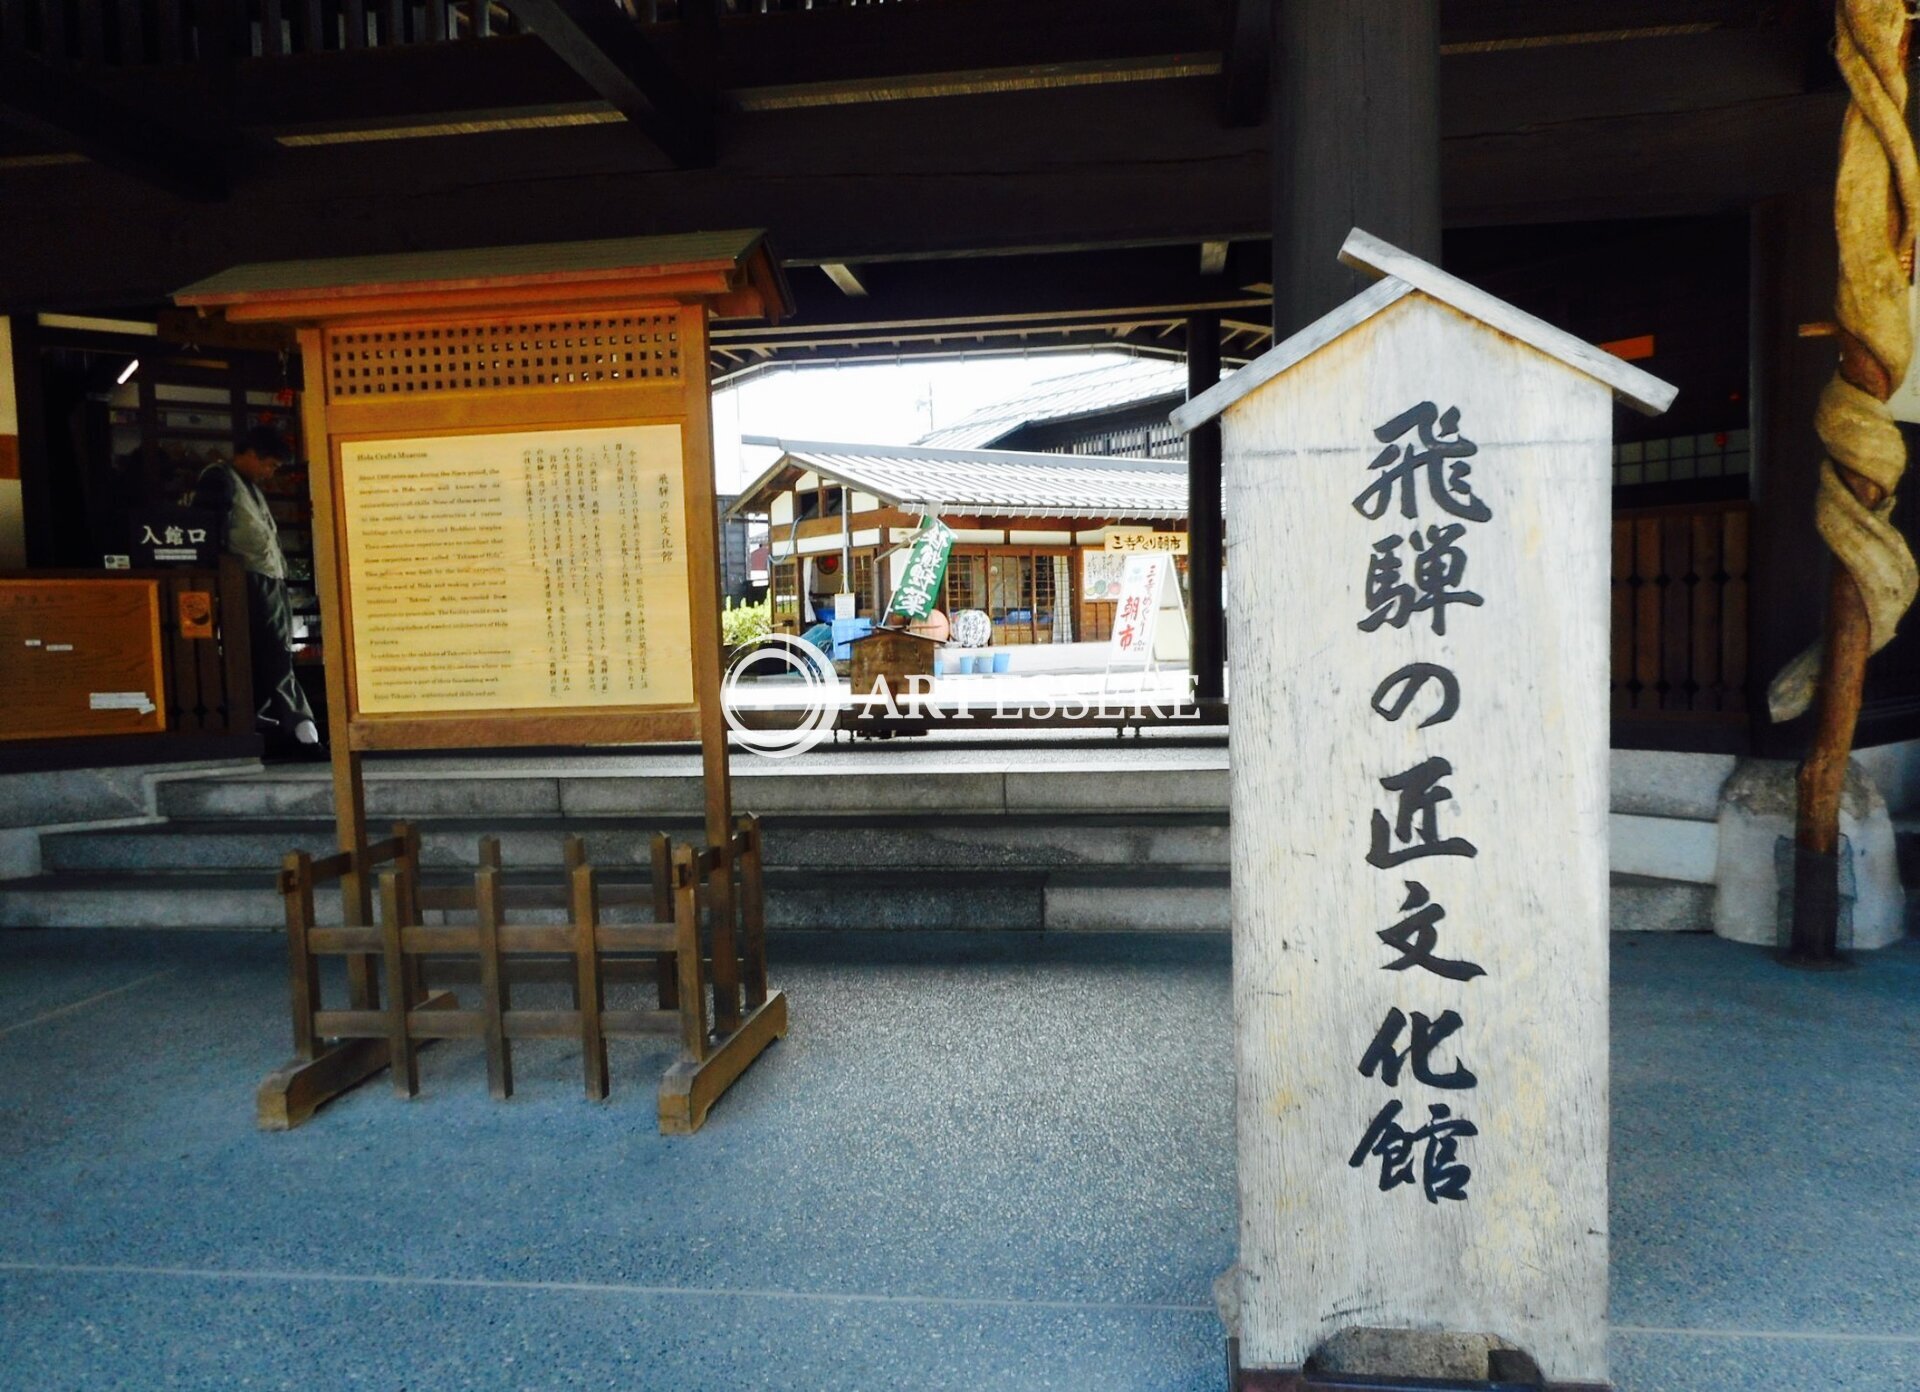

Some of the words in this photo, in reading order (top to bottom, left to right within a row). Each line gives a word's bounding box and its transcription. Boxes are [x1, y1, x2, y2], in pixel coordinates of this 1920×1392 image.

[140, 525, 207, 545] 入館口
[1119, 595, 1140, 651] 朝市
[1349, 401, 1492, 1204] 飛騨の匠文化館
